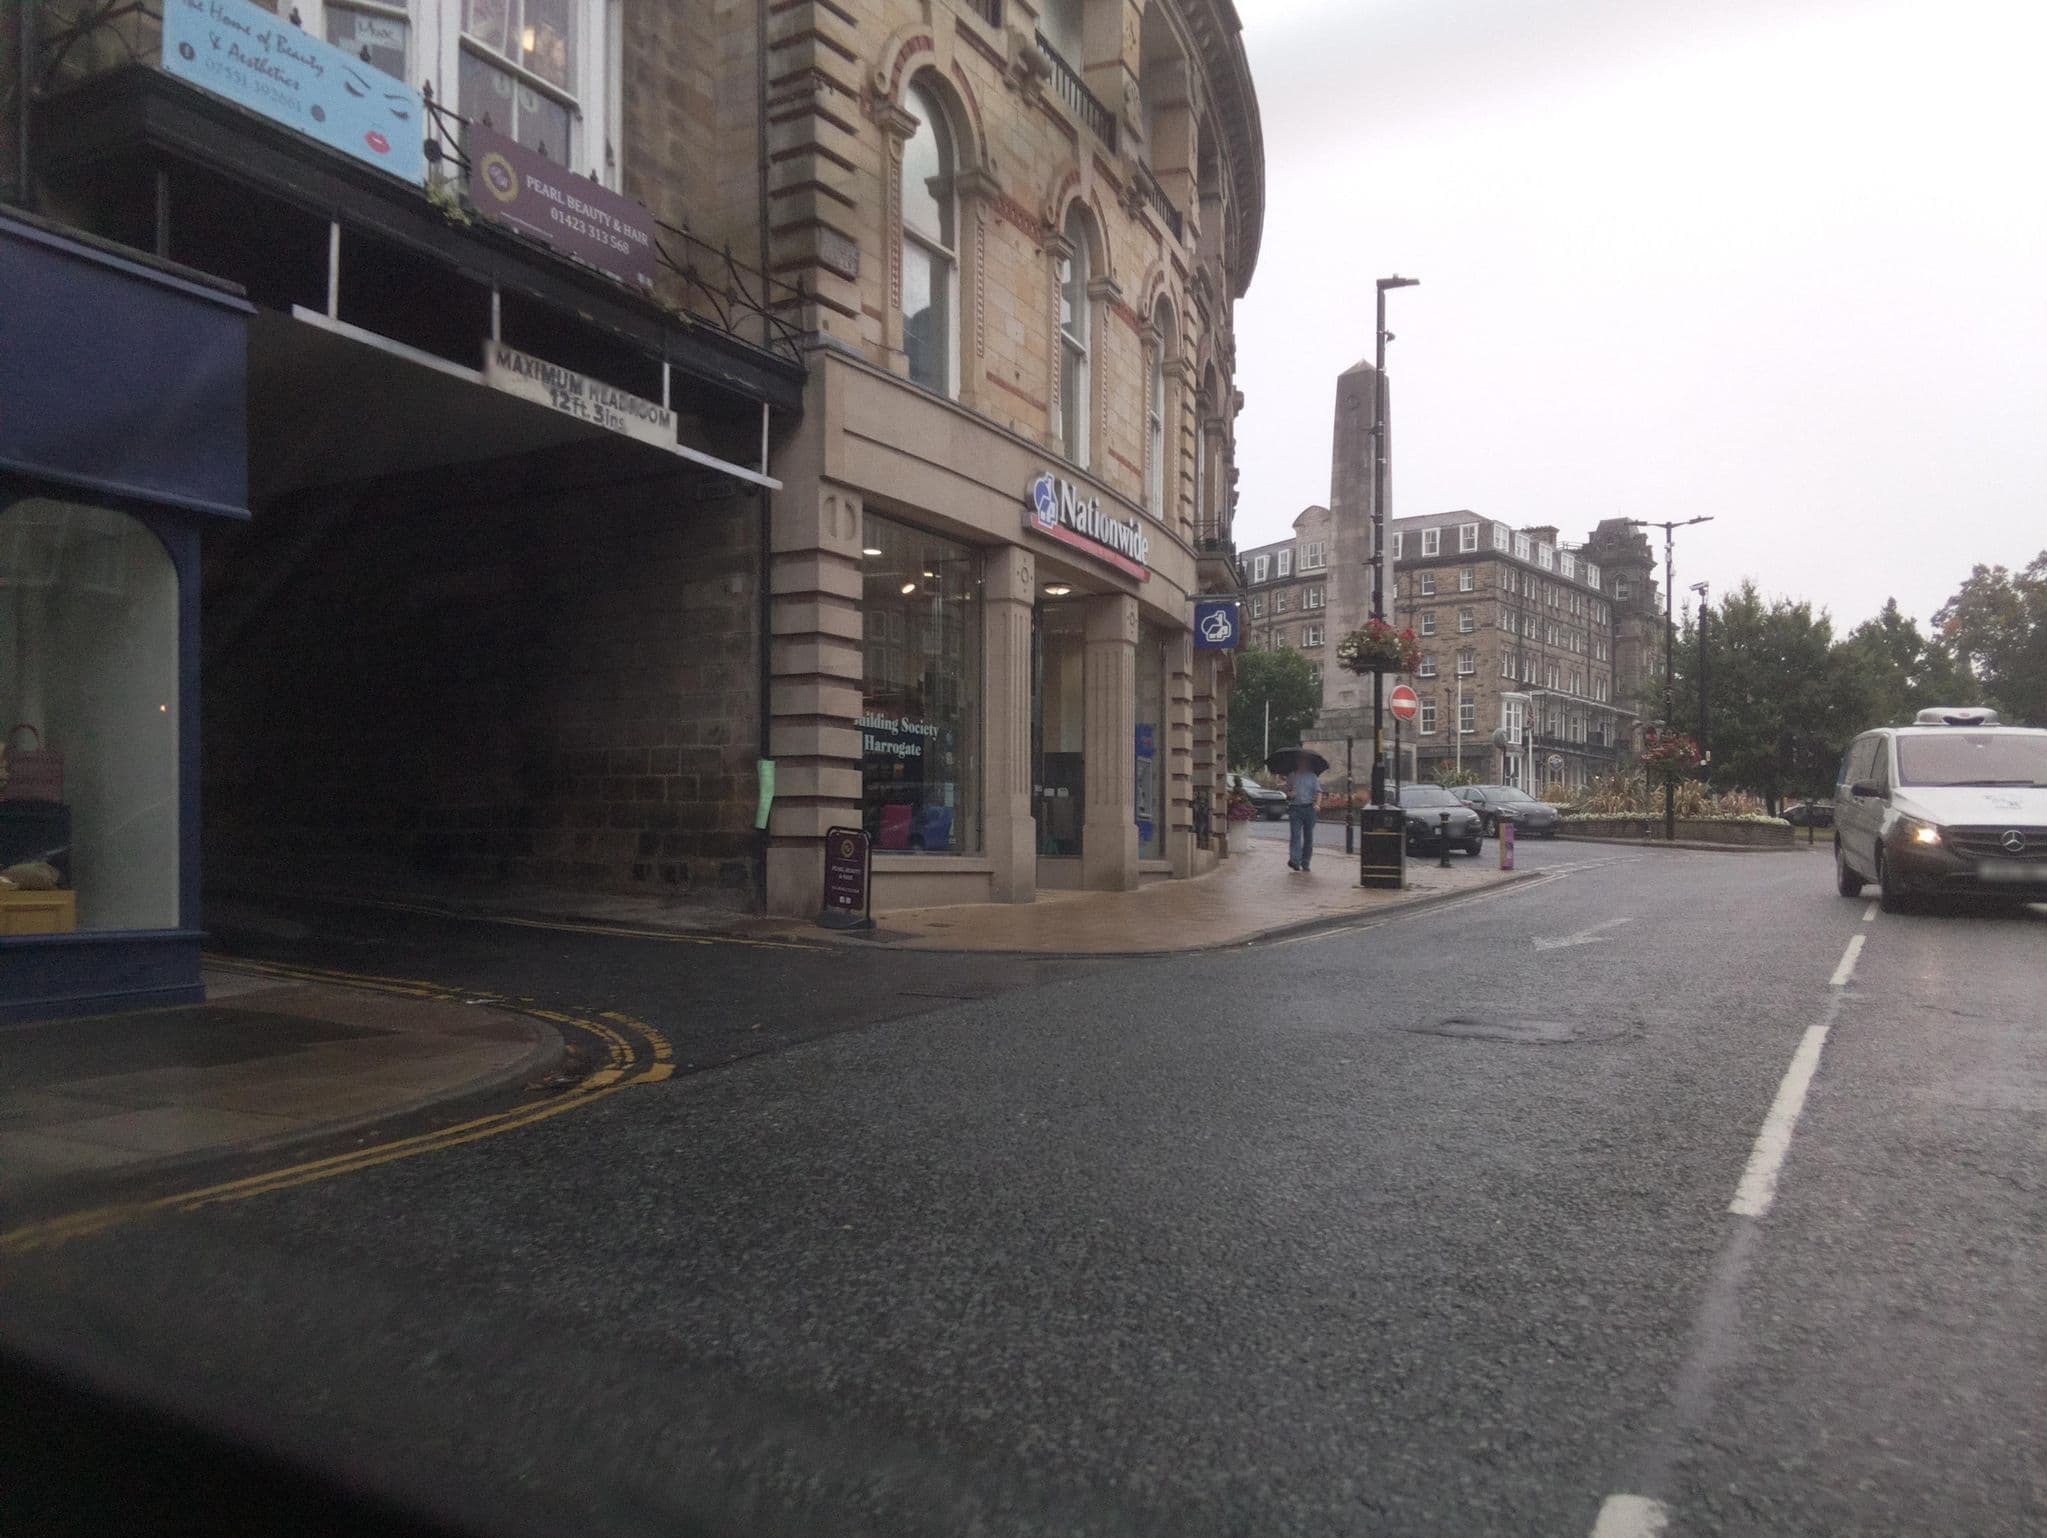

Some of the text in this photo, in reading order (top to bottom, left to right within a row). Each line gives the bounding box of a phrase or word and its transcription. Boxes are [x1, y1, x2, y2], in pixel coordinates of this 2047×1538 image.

[209, 1, 251, 35] Home
[256, 30, 272, 52] of
[277, 34, 324, 78] Beauty
[228, 43, 300, 91] Aesthetics
[526, 175, 649, 247] PEARL BEAUTY & HAIR
[550, 207, 586, 234] 01423
[588, 225, 609, 244] 313
[496, 350, 671, 427] MAXIMUM HEADOOM
[1060, 480, 1148, 565] Nationwide
[854, 711, 940, 741] uilding Society
[864, 734, 921, 758] Harrogate
